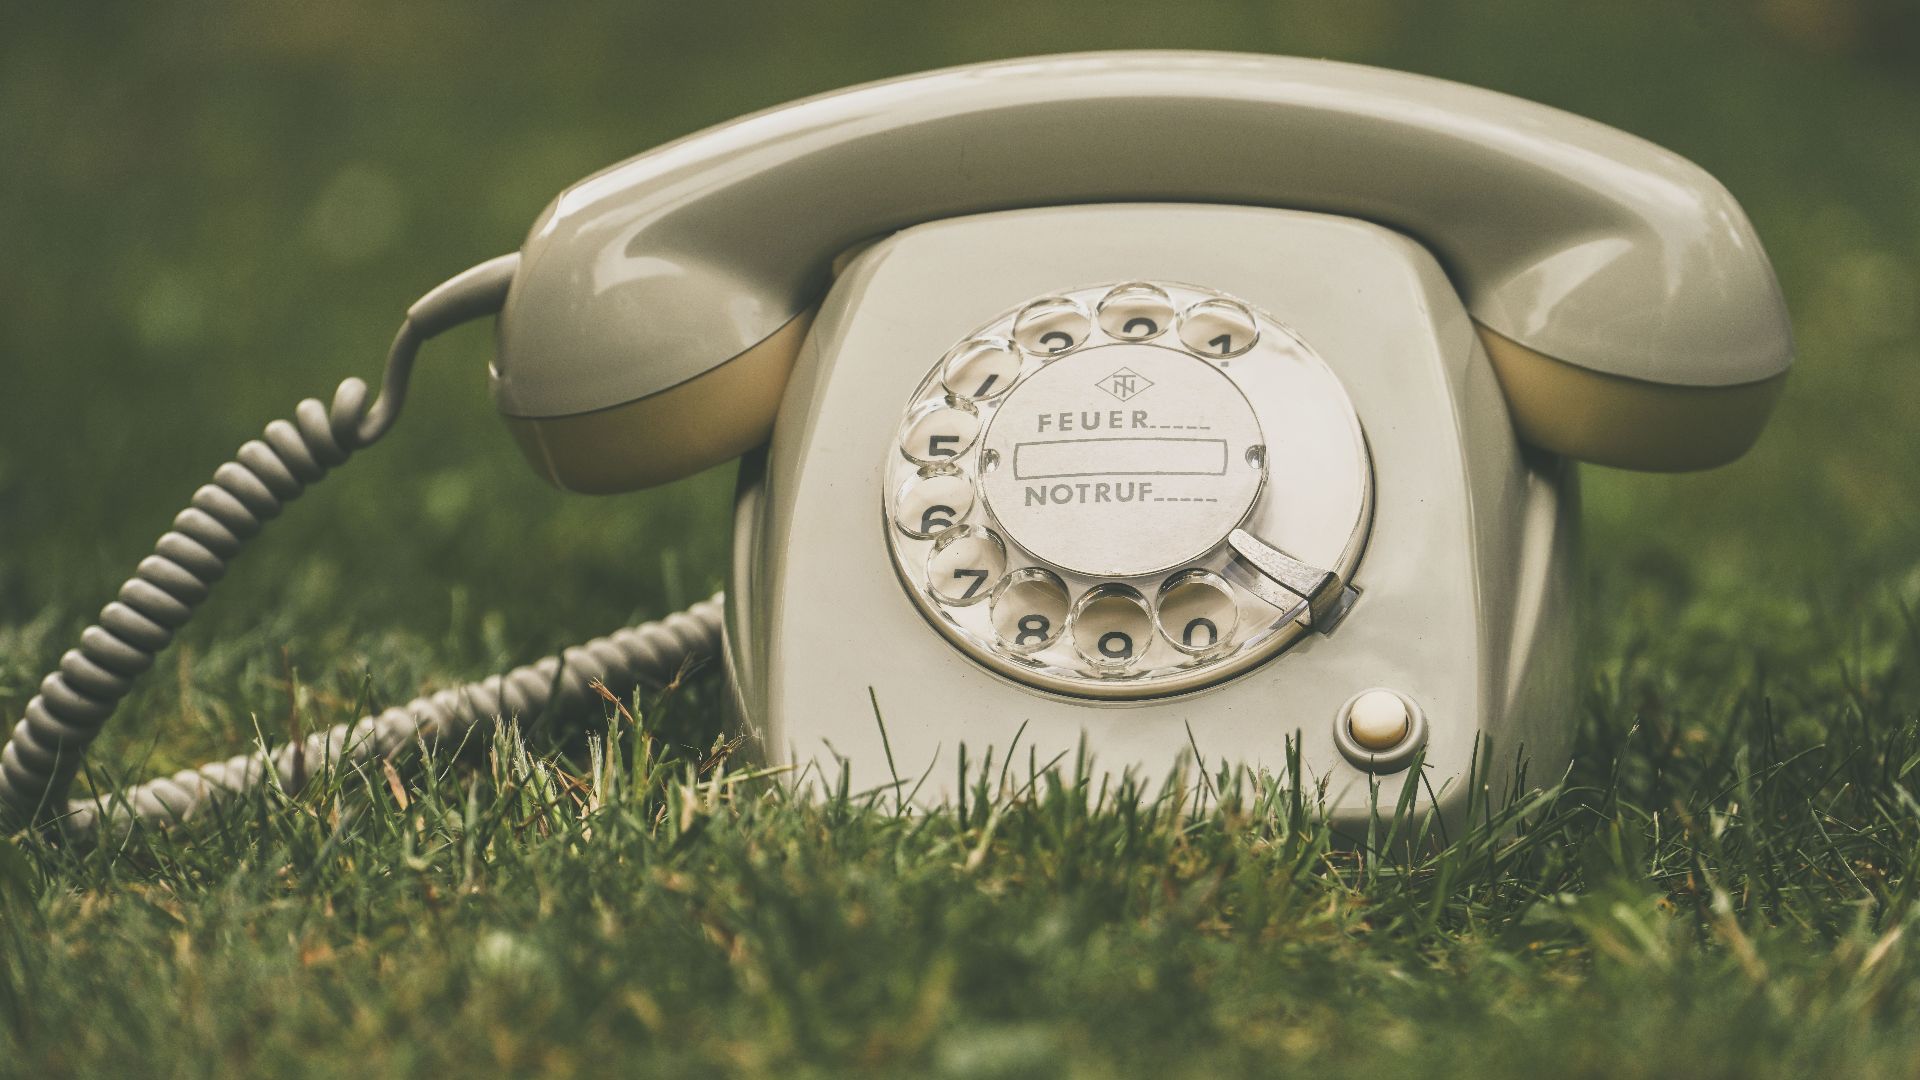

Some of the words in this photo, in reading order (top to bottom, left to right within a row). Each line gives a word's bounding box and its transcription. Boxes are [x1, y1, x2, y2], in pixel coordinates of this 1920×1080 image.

[1037, 410, 1149, 433] FEUER
[928, 435, 960, 458] 5
[1024, 481, 1153, 507] NOTRUF
[920, 504, 957, 534] 6
[953, 568, 989, 600] 7
[1015, 614, 1050, 646] 8
[1182, 617, 1218, 647] 0
[1097, 631, 1133, 660] 9
